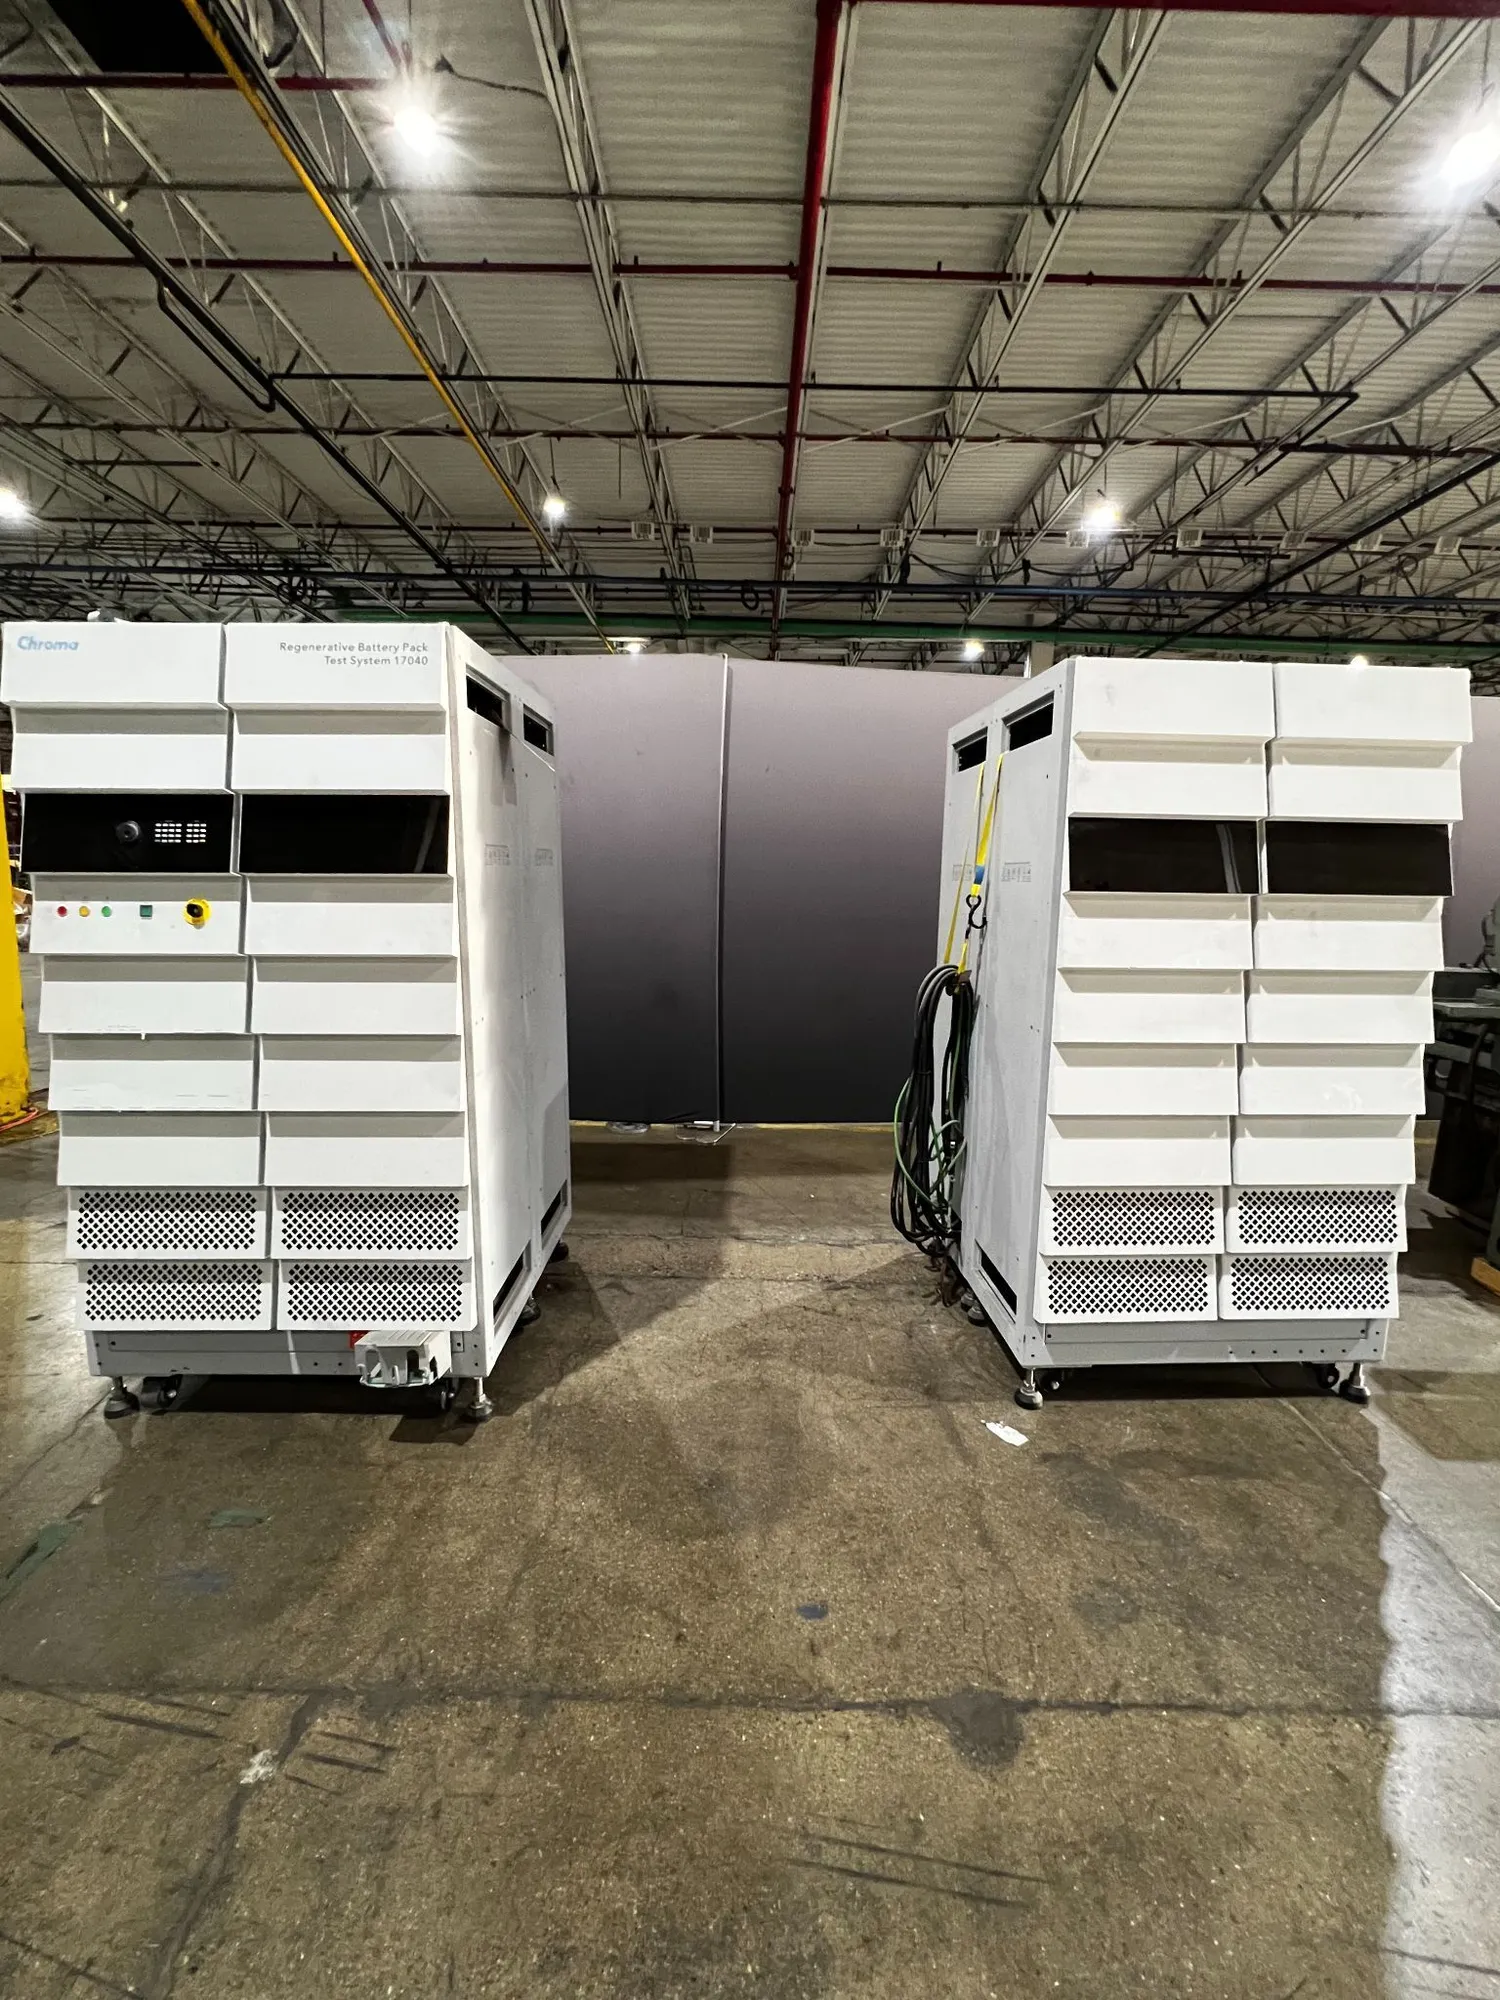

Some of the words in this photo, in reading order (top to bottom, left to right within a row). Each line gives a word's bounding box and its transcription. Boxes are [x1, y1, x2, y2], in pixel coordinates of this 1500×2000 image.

[17, 635, 79, 650] Chroma
[279, 642, 355, 653] Regenerative
[357, 642, 400, 654] Battery
[402, 642, 429, 652] Pack
[324, 655, 348, 665] Test
[350, 655, 391, 667] System
[394, 655, 429, 665] 17040
